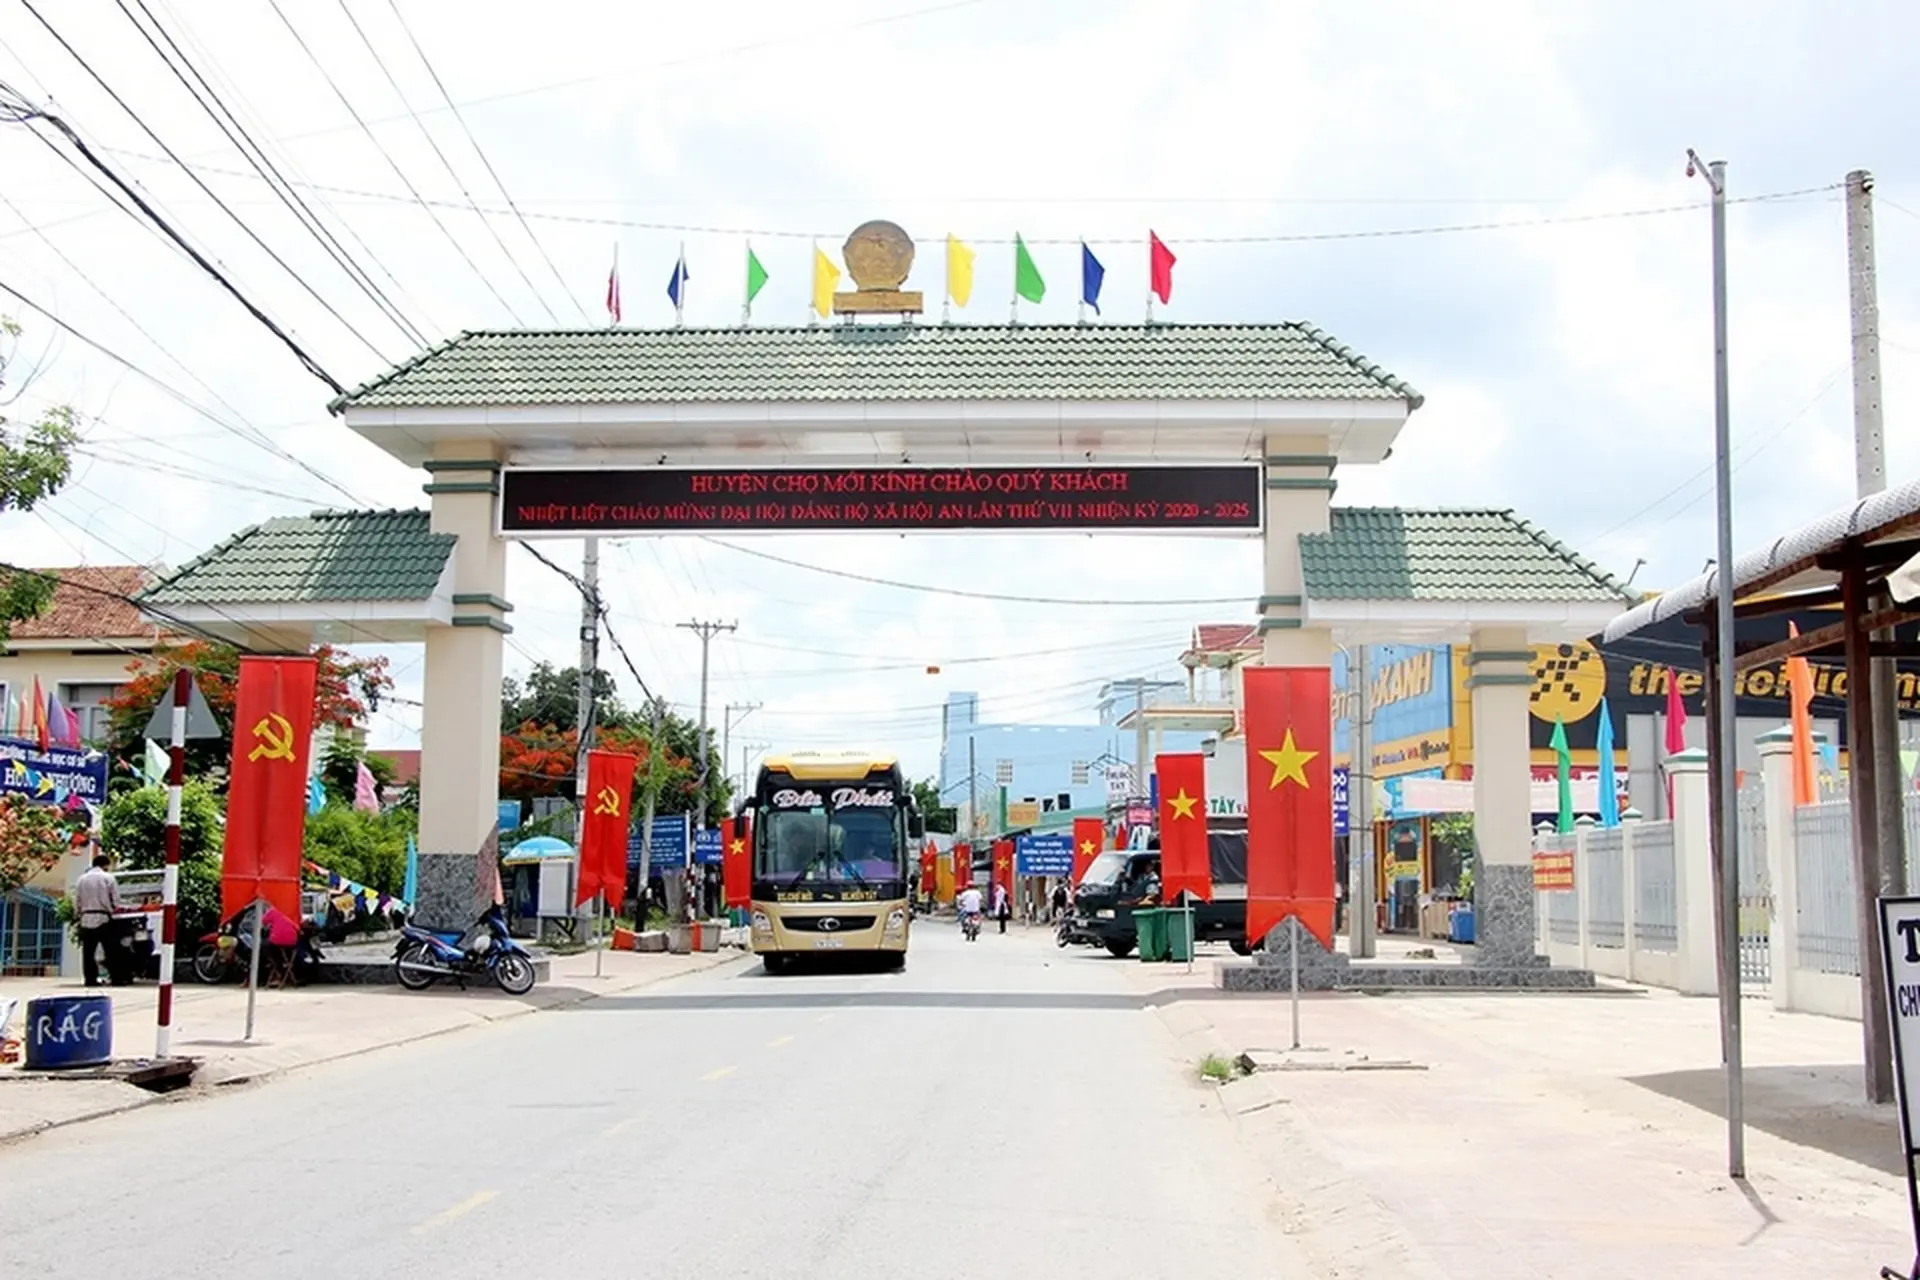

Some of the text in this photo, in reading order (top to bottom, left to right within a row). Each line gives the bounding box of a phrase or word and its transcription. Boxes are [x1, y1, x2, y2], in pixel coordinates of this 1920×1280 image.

[690, 469, 1129, 494] HUYỆN CHỢ MỚI KÍNH CHÀO QUÝ KHÁCH
[937, 504, 963, 519] AN
[1163, 503, 1202, 518] 2020
[1216, 503, 1249, 518] 2025
